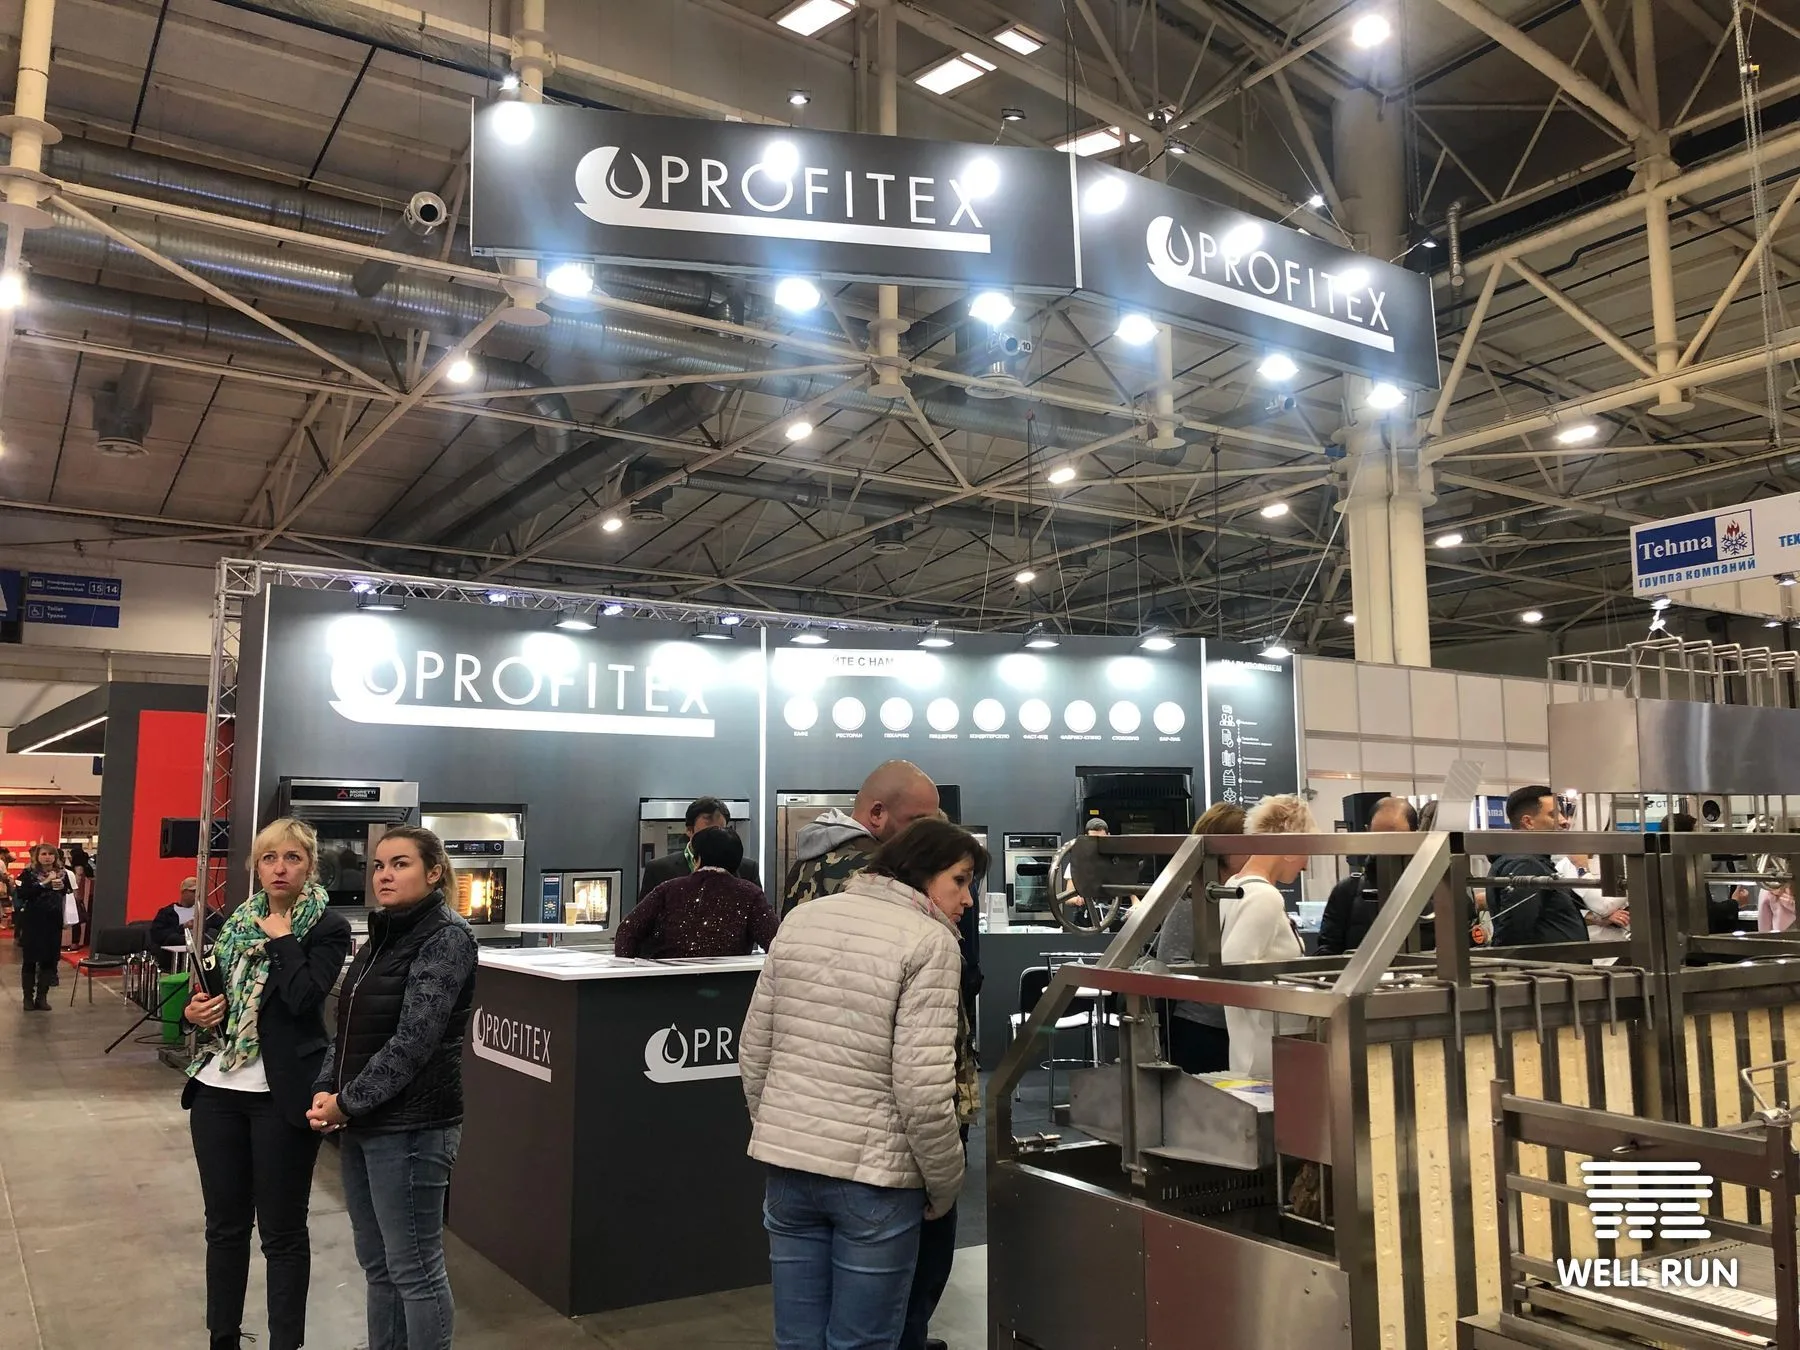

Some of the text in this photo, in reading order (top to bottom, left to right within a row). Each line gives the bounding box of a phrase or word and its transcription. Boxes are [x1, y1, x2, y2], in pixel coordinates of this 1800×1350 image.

[661, 155, 983, 228] PROFITEX
[1199, 231, 1390, 331] PROFITEX
[1022, 341, 1031, 351] 10
[1638, 535, 1713, 561] Tehma
[91, 584, 117, 593] 15 14
[1638, 558, 1756, 588] группа компаний
[415, 650, 710, 714] PROFITEX
[484, 1013, 551, 1064] PROFITEX
